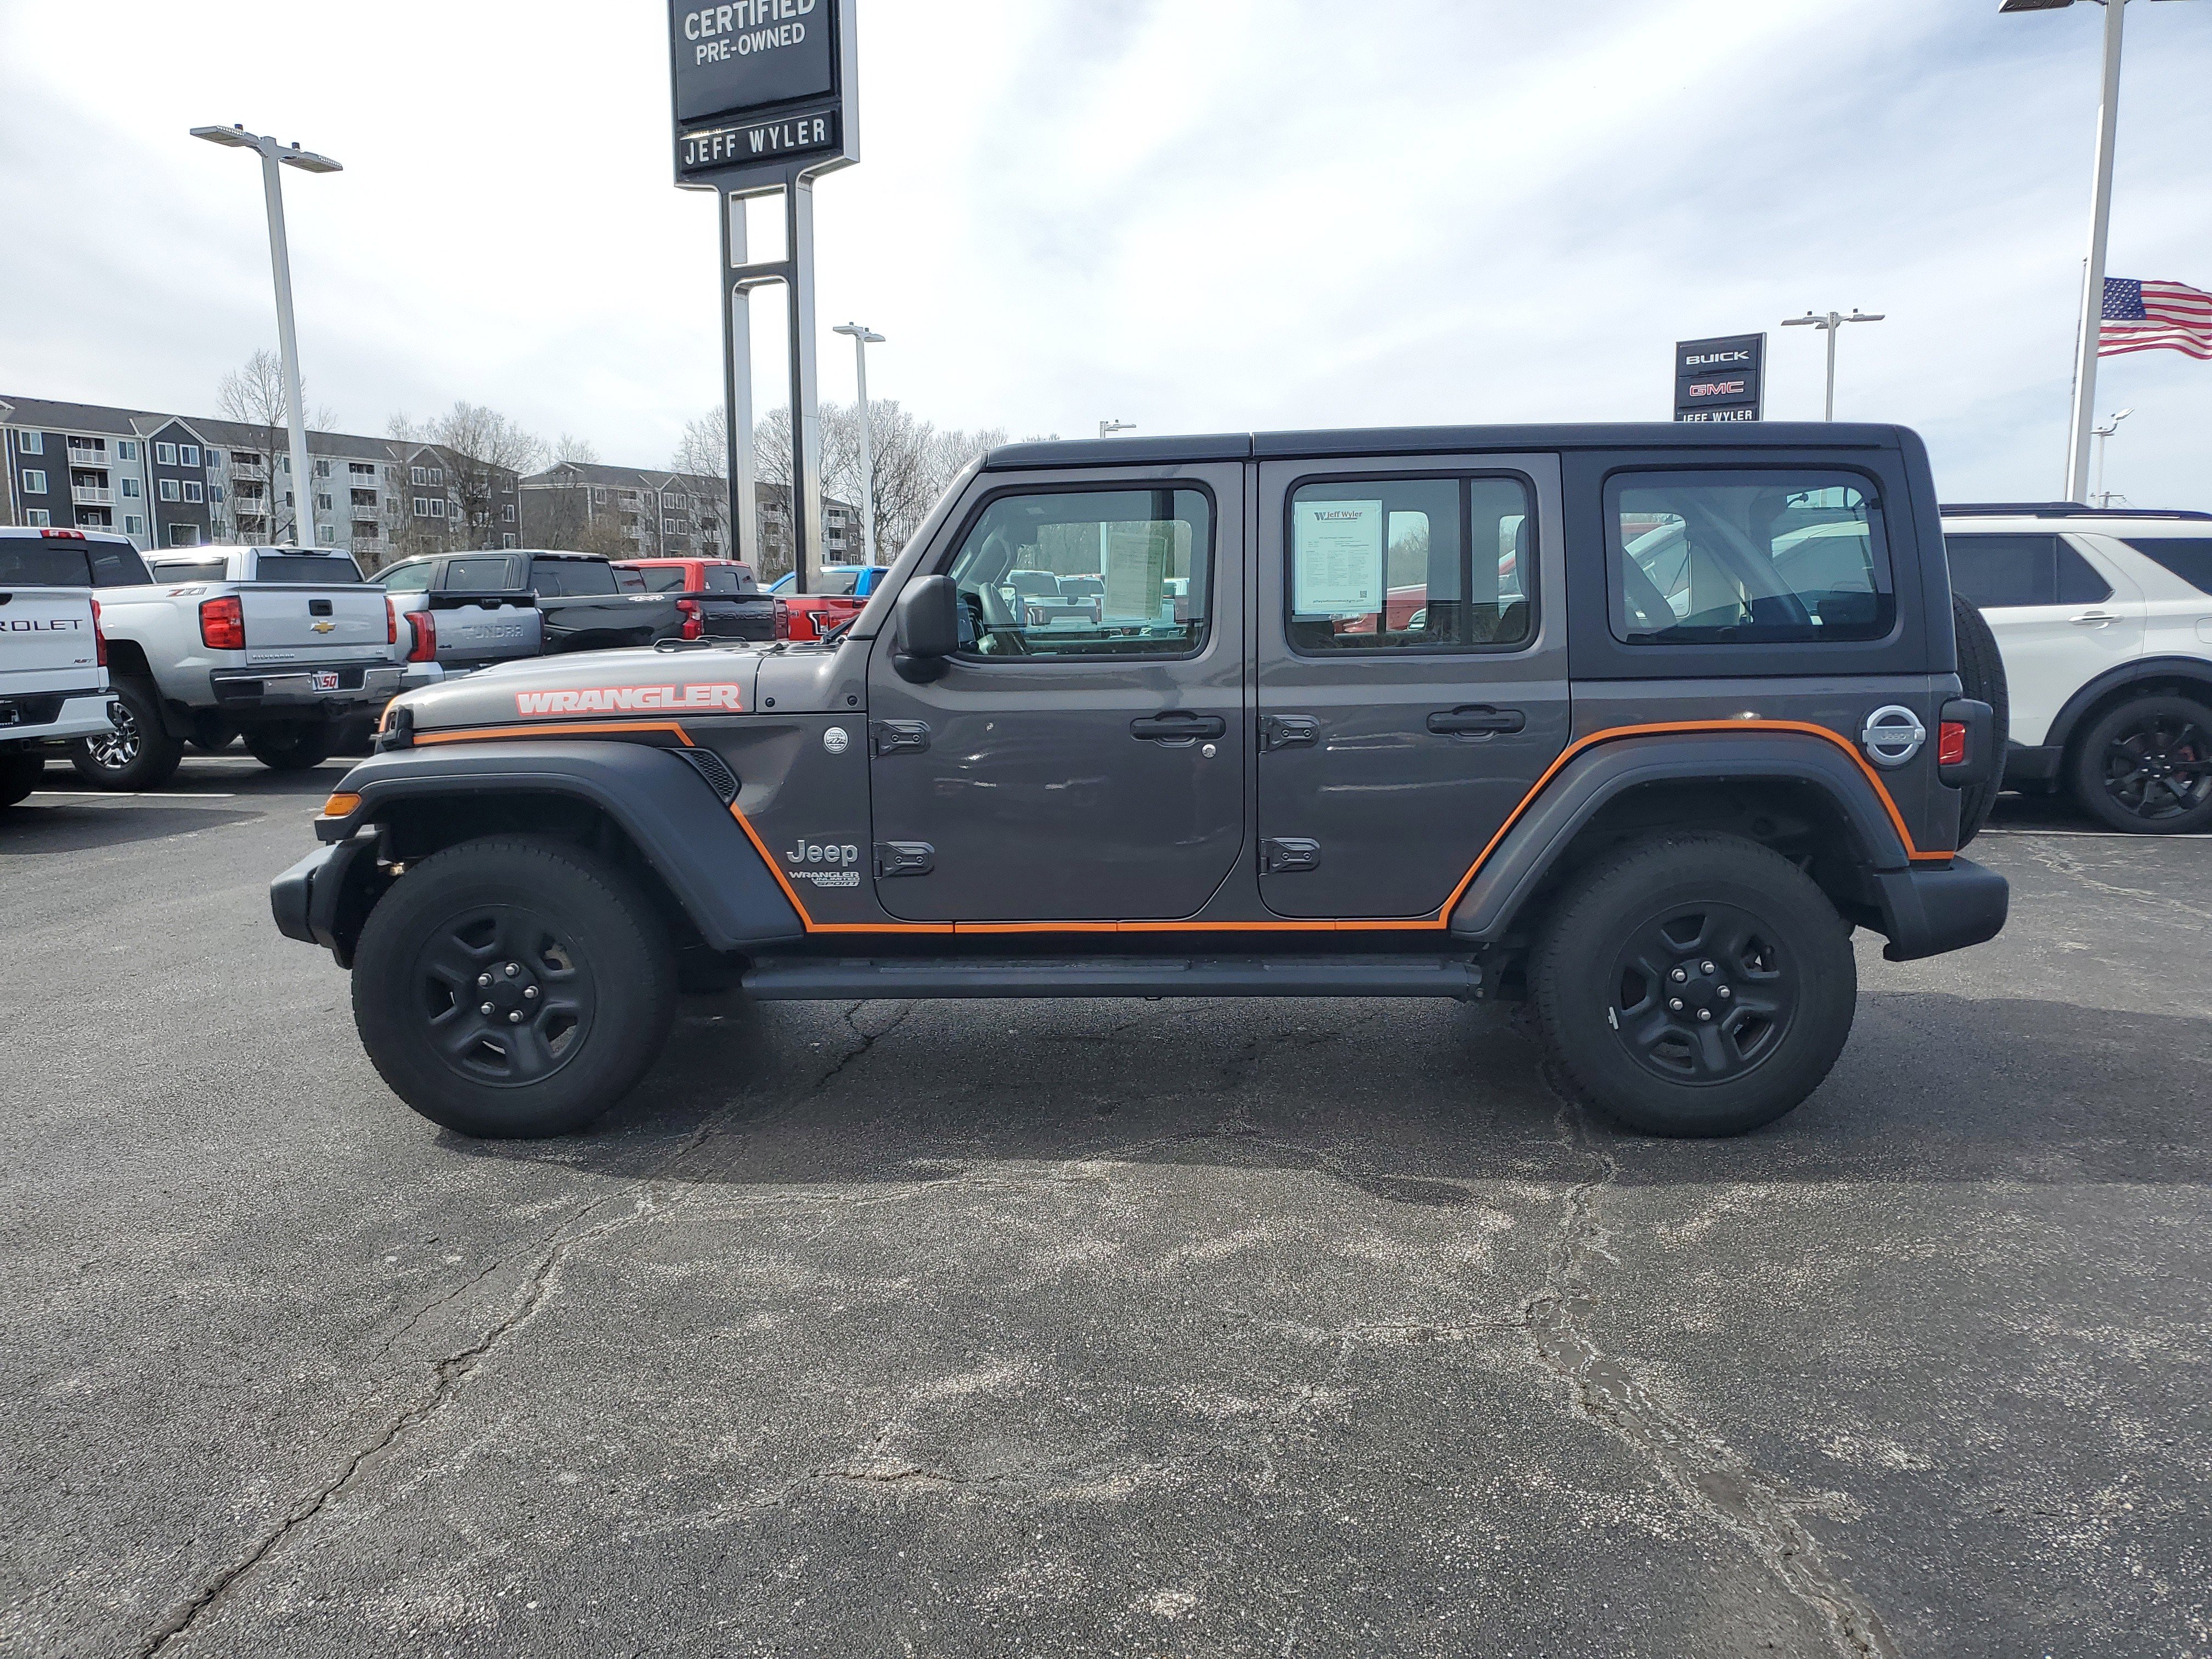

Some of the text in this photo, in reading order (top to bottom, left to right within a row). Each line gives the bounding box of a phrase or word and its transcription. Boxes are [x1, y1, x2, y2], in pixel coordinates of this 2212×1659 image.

[685, 0, 816, 41] CERTIFIED
[696, 23, 805, 66] PRE-OWNED
[685, 119, 825, 166] JEFF WYLER
[1686, 351, 1750, 365] BUICK
[1689, 380, 1744, 397] GMC
[1712, 410, 1752, 422] WYLER
[1341, 510, 1363, 518] Wyler
[166, 586, 207, 597] Z71
[462, 624, 523, 639] TUNDRA
[516, 684, 742, 715] WRANGLER
[1881, 731, 1908, 742] Jeep
[786, 839, 859, 867] Jeep
